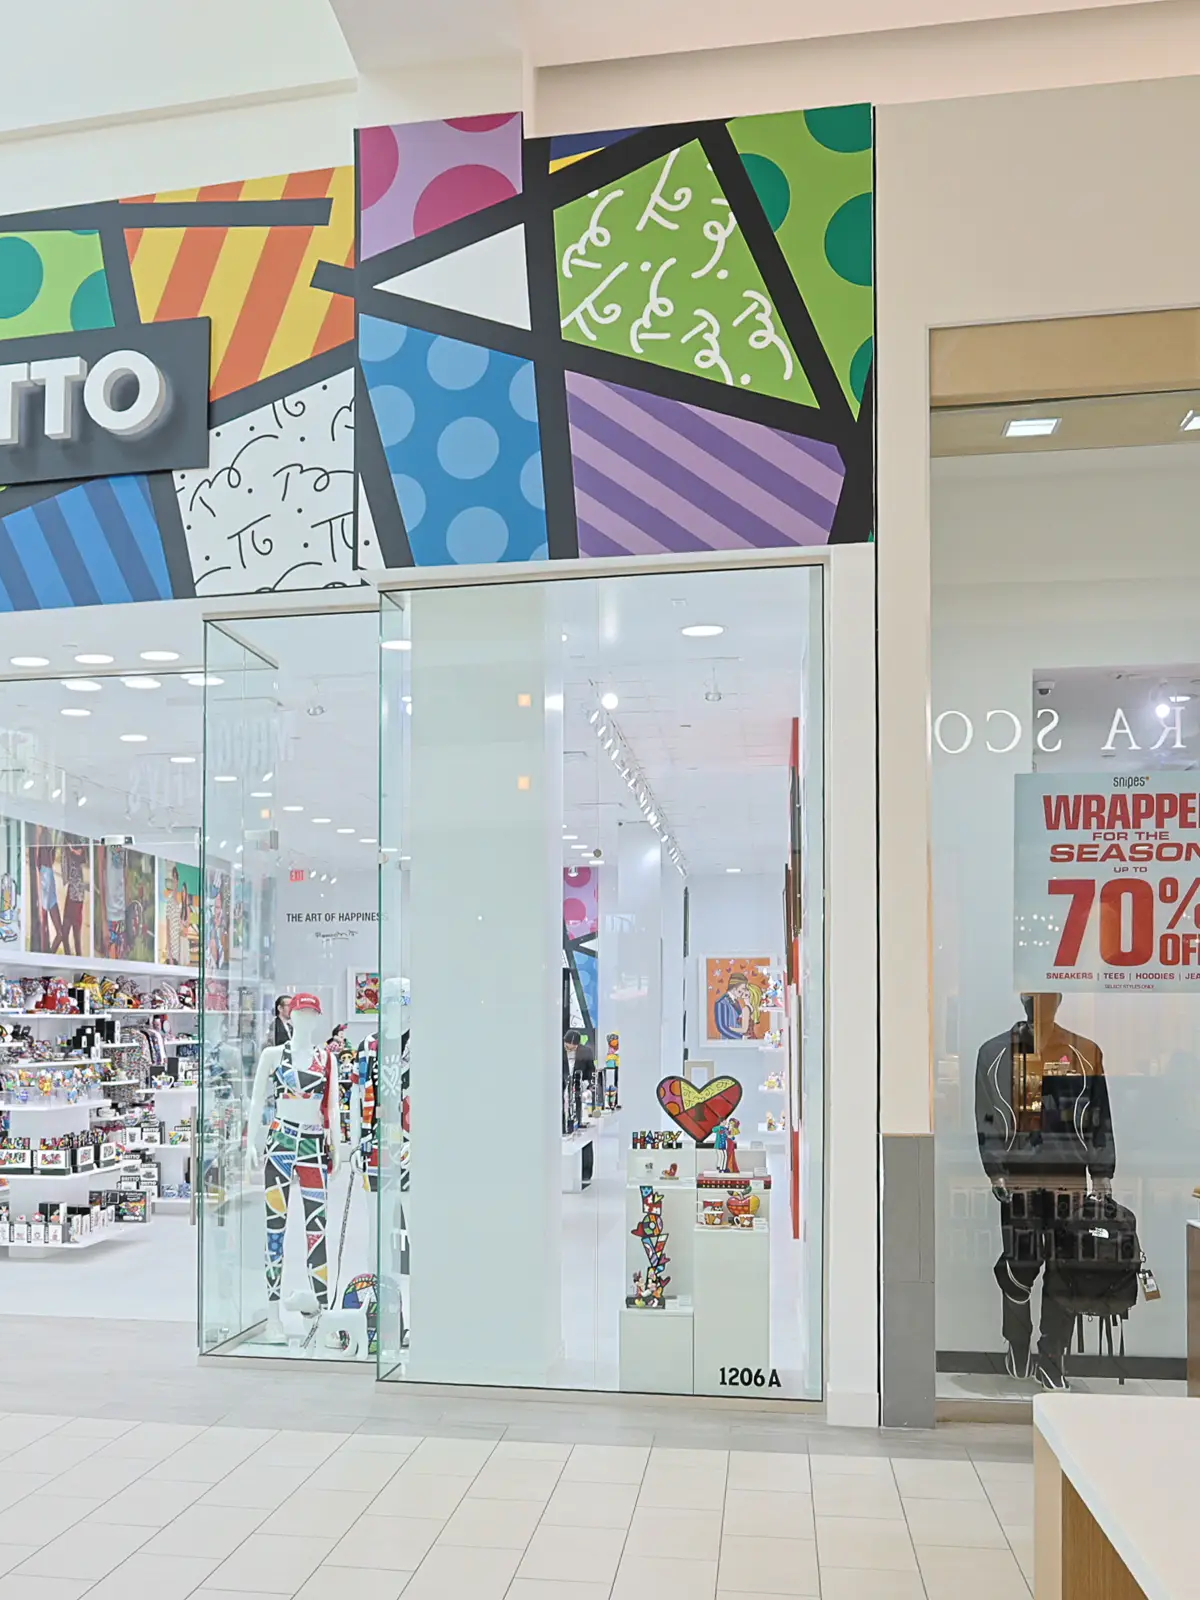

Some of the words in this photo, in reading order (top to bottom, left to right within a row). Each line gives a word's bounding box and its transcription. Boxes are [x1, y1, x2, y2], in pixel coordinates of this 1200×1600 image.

[1113, 776, 1146, 788] snipes
[1043, 793, 1200, 830] WRAPPE
[1092, 832, 1128, 841] FOR
[1135, 831, 1170, 840] THE
[286, 913, 303, 922] THE
[305, 913, 321, 922] ART
[324, 913, 336, 922] OF
[1159, 933, 1200, 966] OF
[1046, 972, 1093, 980] SNEAKERS
[1104, 972, 1125, 980] TEES
[1136, 972, 1175, 980] HOODIES
[632, 1130, 682, 1149] HAPPY
[719, 1367, 782, 1387] 1206A
